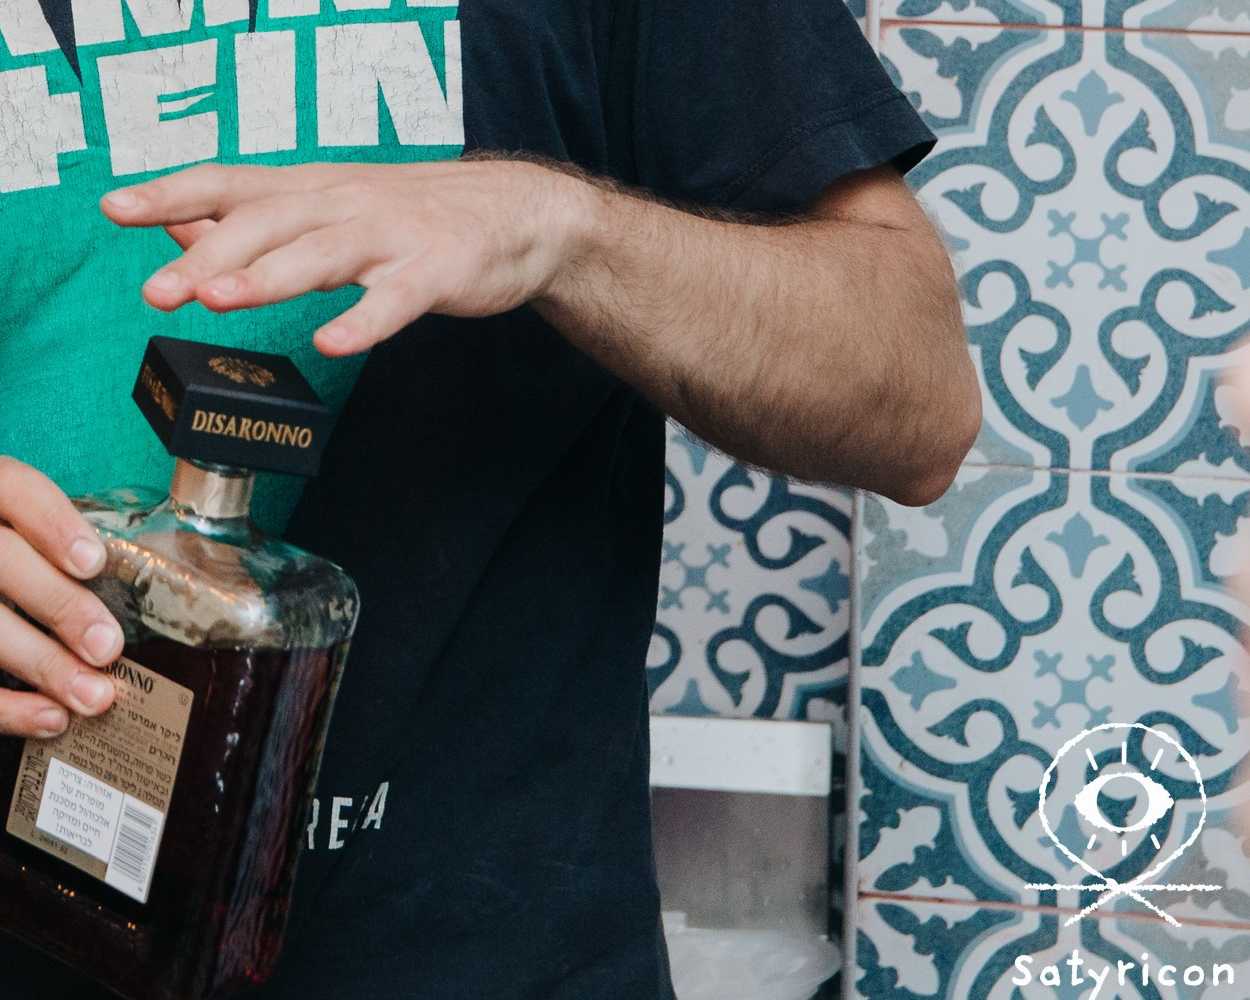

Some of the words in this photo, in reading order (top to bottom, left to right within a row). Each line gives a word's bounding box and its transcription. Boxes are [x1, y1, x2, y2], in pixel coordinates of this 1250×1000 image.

[191, 408, 313, 449] DISARONNO
[58, 765, 82, 784] צריכה
[60, 780, 73, 794] של
[83, 778, 112, 799] אזהרה:
[48, 790, 77, 811] מסכנת
[74, 788, 105, 810] מופרזת
[52, 806, 81, 828] ומזיקה
[77, 804, 110, 828] אלכוהול
[55, 821, 92, 849] לבריאות!
[81, 822, 101, 838] חיים
